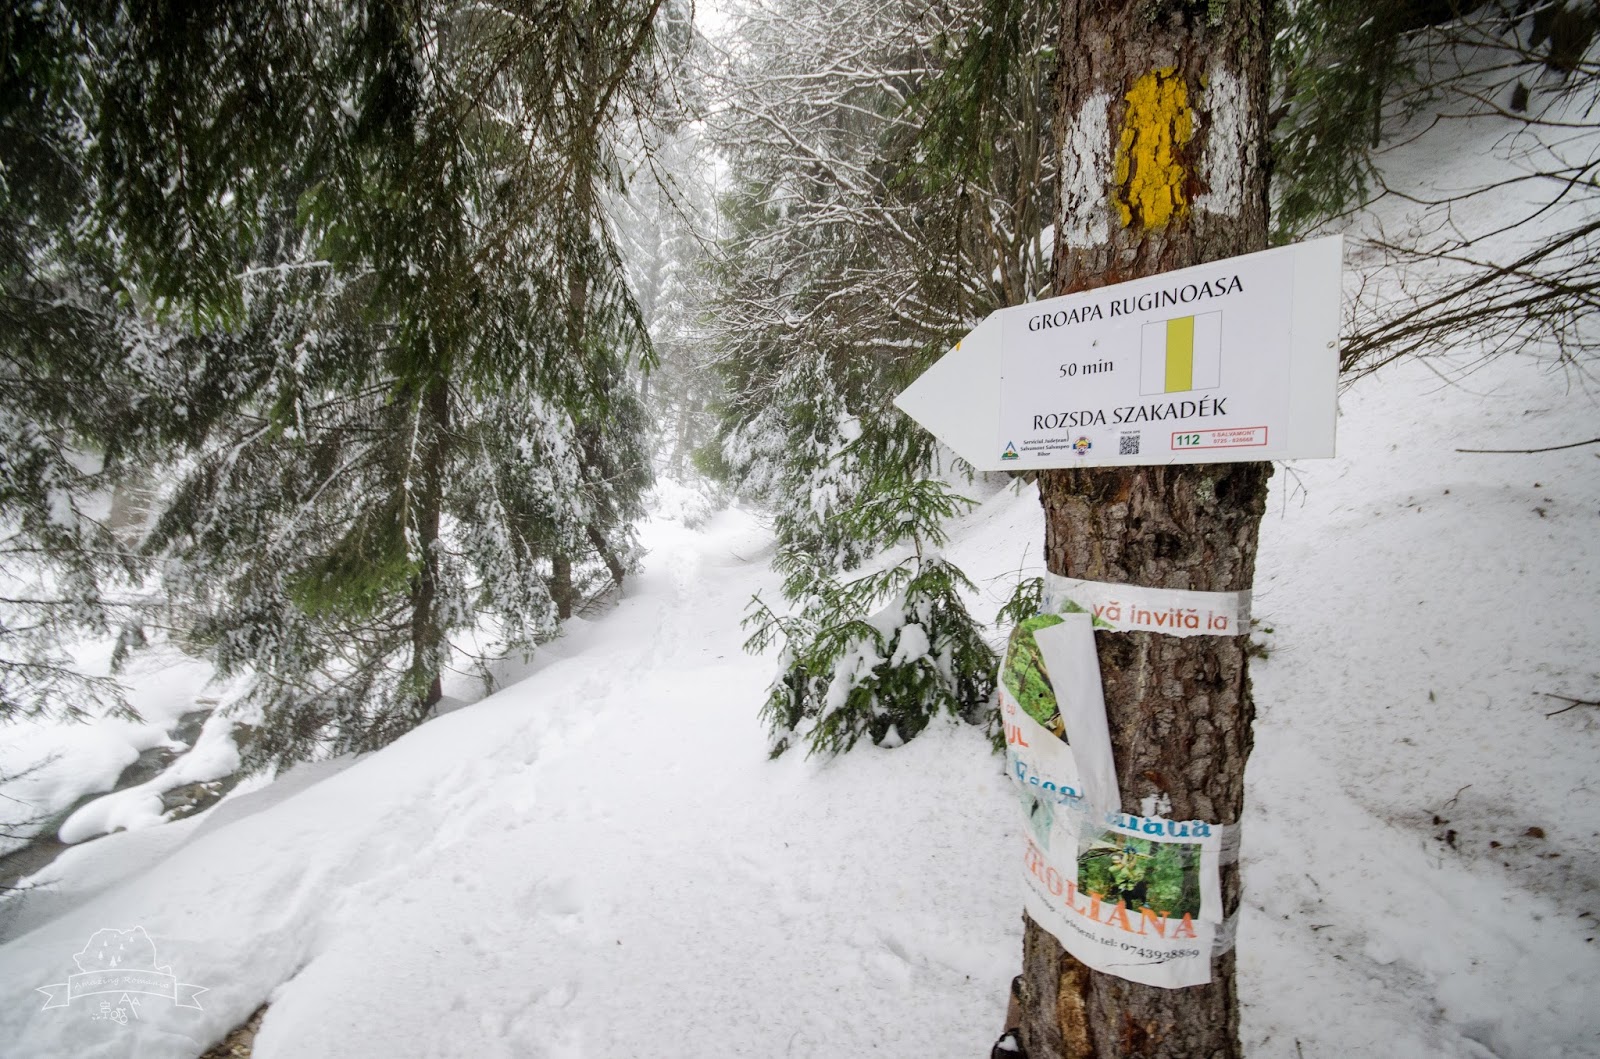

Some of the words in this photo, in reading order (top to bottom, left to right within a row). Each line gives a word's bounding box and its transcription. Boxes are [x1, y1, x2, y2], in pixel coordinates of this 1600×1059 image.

[1028, 304, 1104, 332] GROAPA
[1110, 274, 1244, 318] RUGINOASA
[1059, 362, 1078, 378] 50
[1082, 358, 1114, 376] min
[1033, 409, 1107, 431] ROZSDA
[1112, 395, 1229, 425] SZAKADÉK
[1176, 434, 1200, 446] 112
[1217, 430, 1256, 438] SALVAMONT
[1092, 601, 1120, 621] vă
[1130, 605, 1200, 630] invită
[1207, 611, 1228, 630] la
[1100, 937, 1118, 947] tel:
